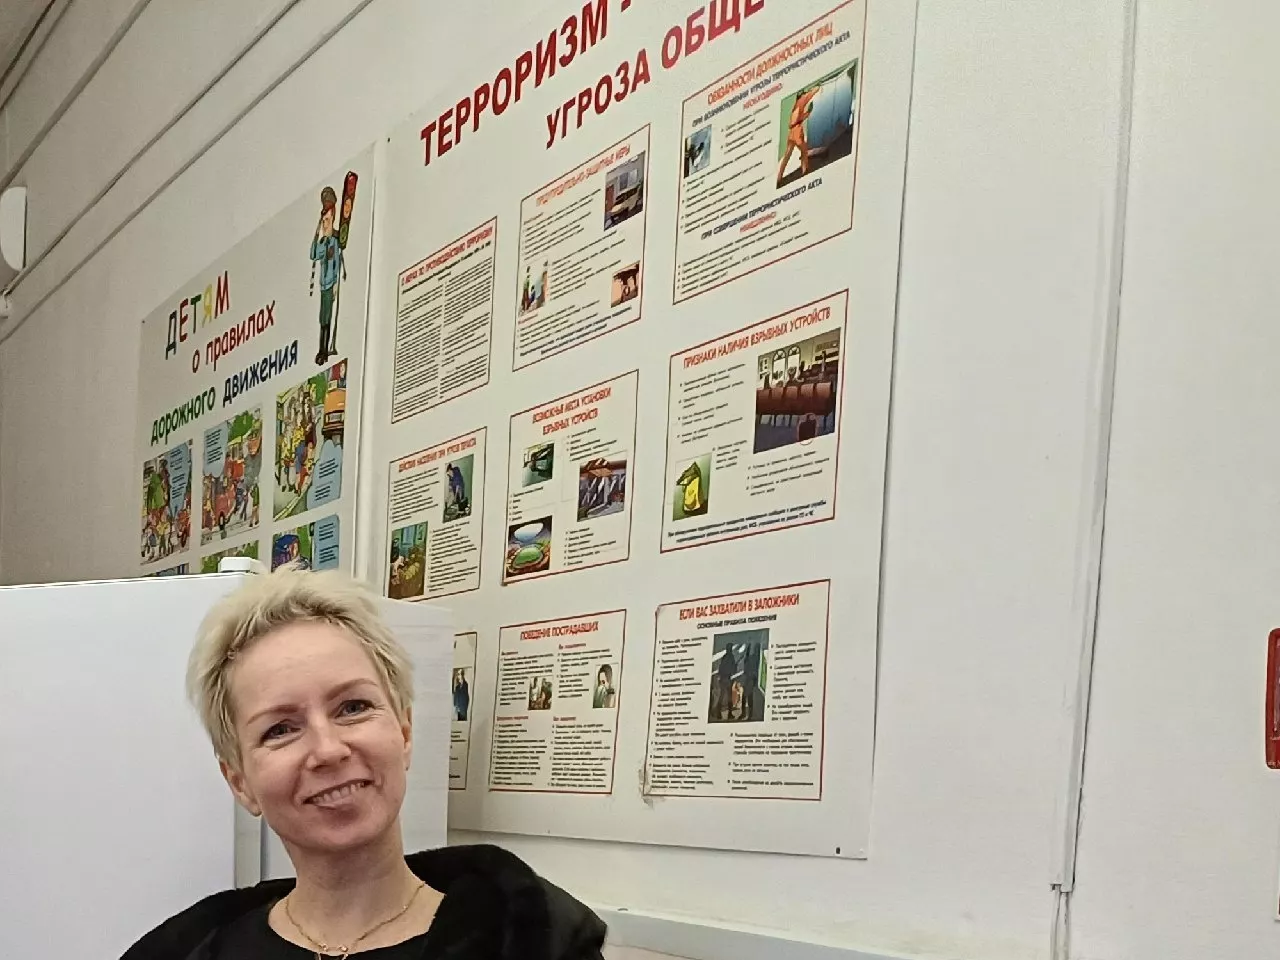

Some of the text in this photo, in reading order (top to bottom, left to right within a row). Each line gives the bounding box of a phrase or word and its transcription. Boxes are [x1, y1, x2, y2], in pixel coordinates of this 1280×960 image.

[420, 0, 608, 166] ТЕРРОРИЗМ
[546, 48, 651, 150] УГРОЗА
[166, 270, 230, 360] ДЕТЯМ
[192, 300, 275, 373] о правилах
[789, 306, 831, 332] УСТРОЙСТВ
[151, 387, 216, 447] дорожного
[223, 340, 298, 408] движения
